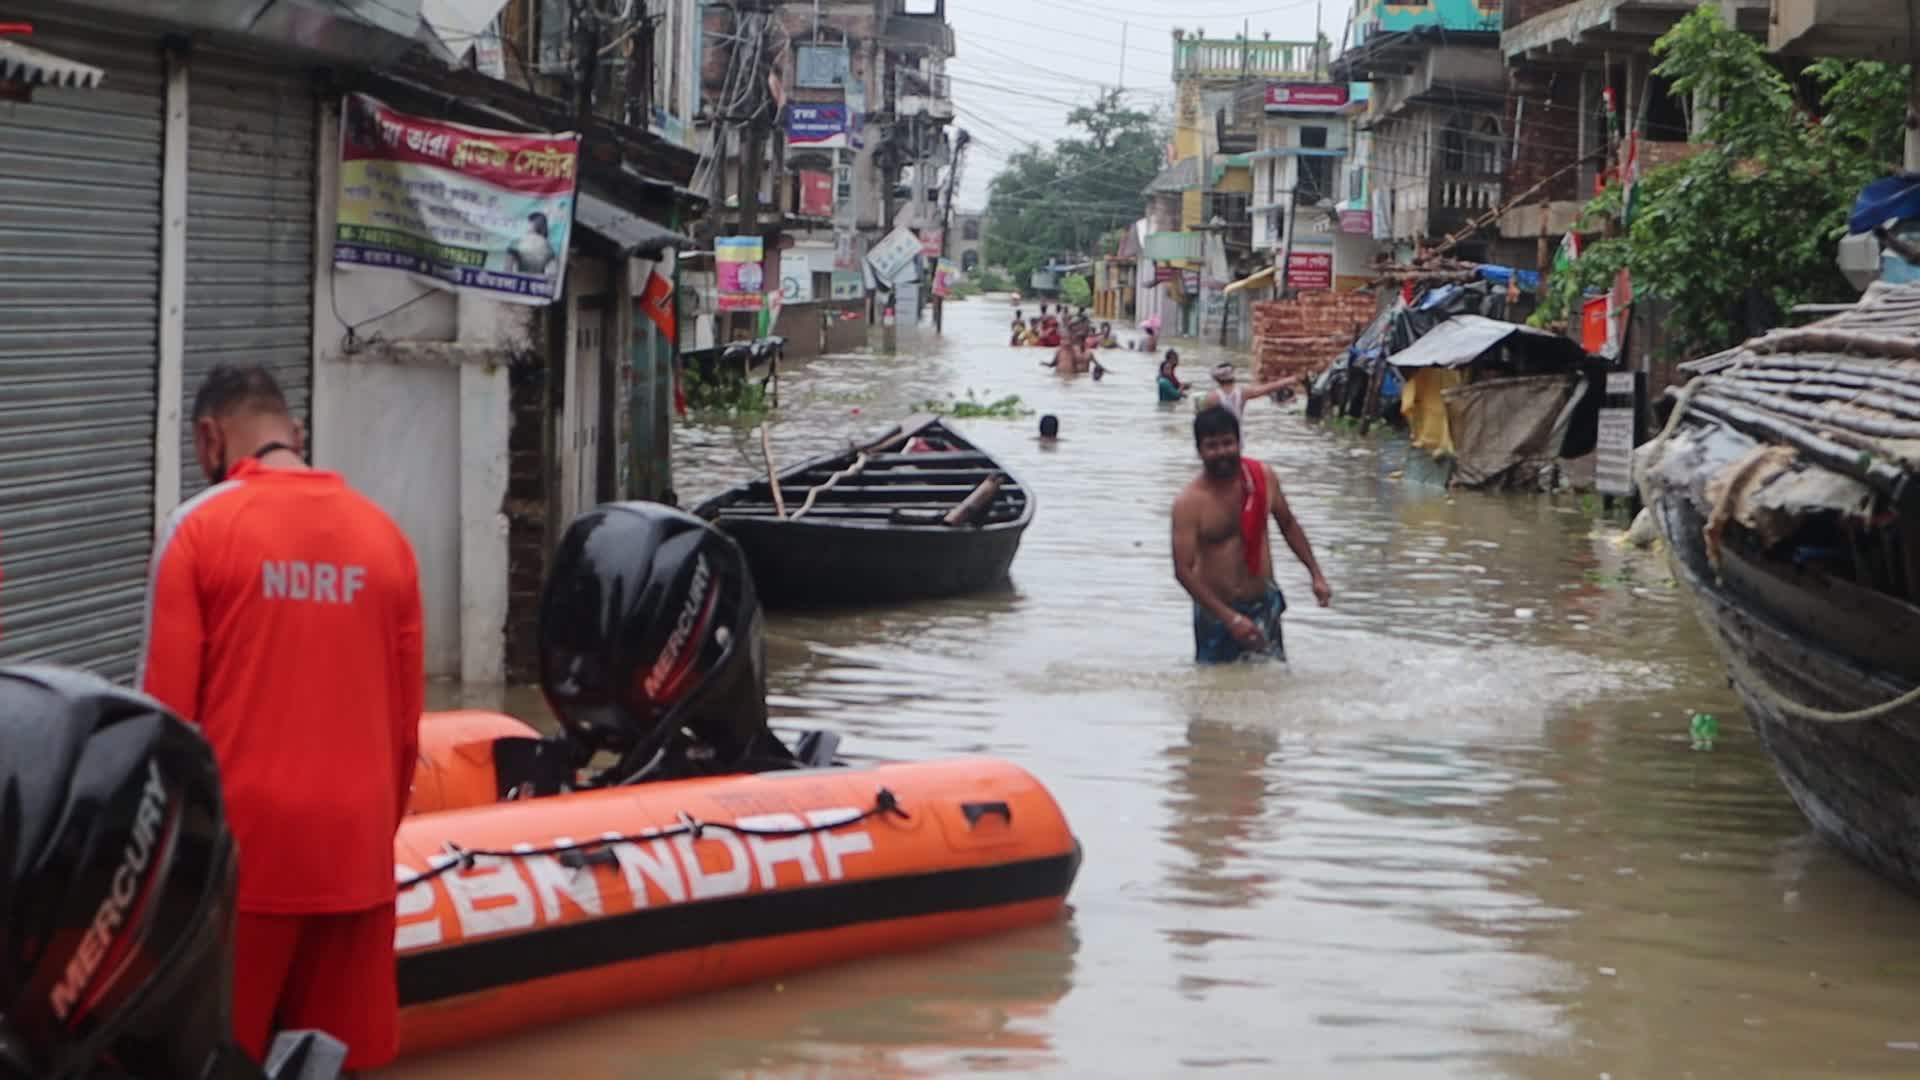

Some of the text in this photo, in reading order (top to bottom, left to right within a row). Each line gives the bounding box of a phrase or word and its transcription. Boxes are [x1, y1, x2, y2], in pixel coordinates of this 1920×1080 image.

[262, 559, 368, 604] NDRF
[643, 552, 711, 698] MERCURY
[51, 758, 168, 1020] MERCURY
[603, 807, 874, 908] NDRF
